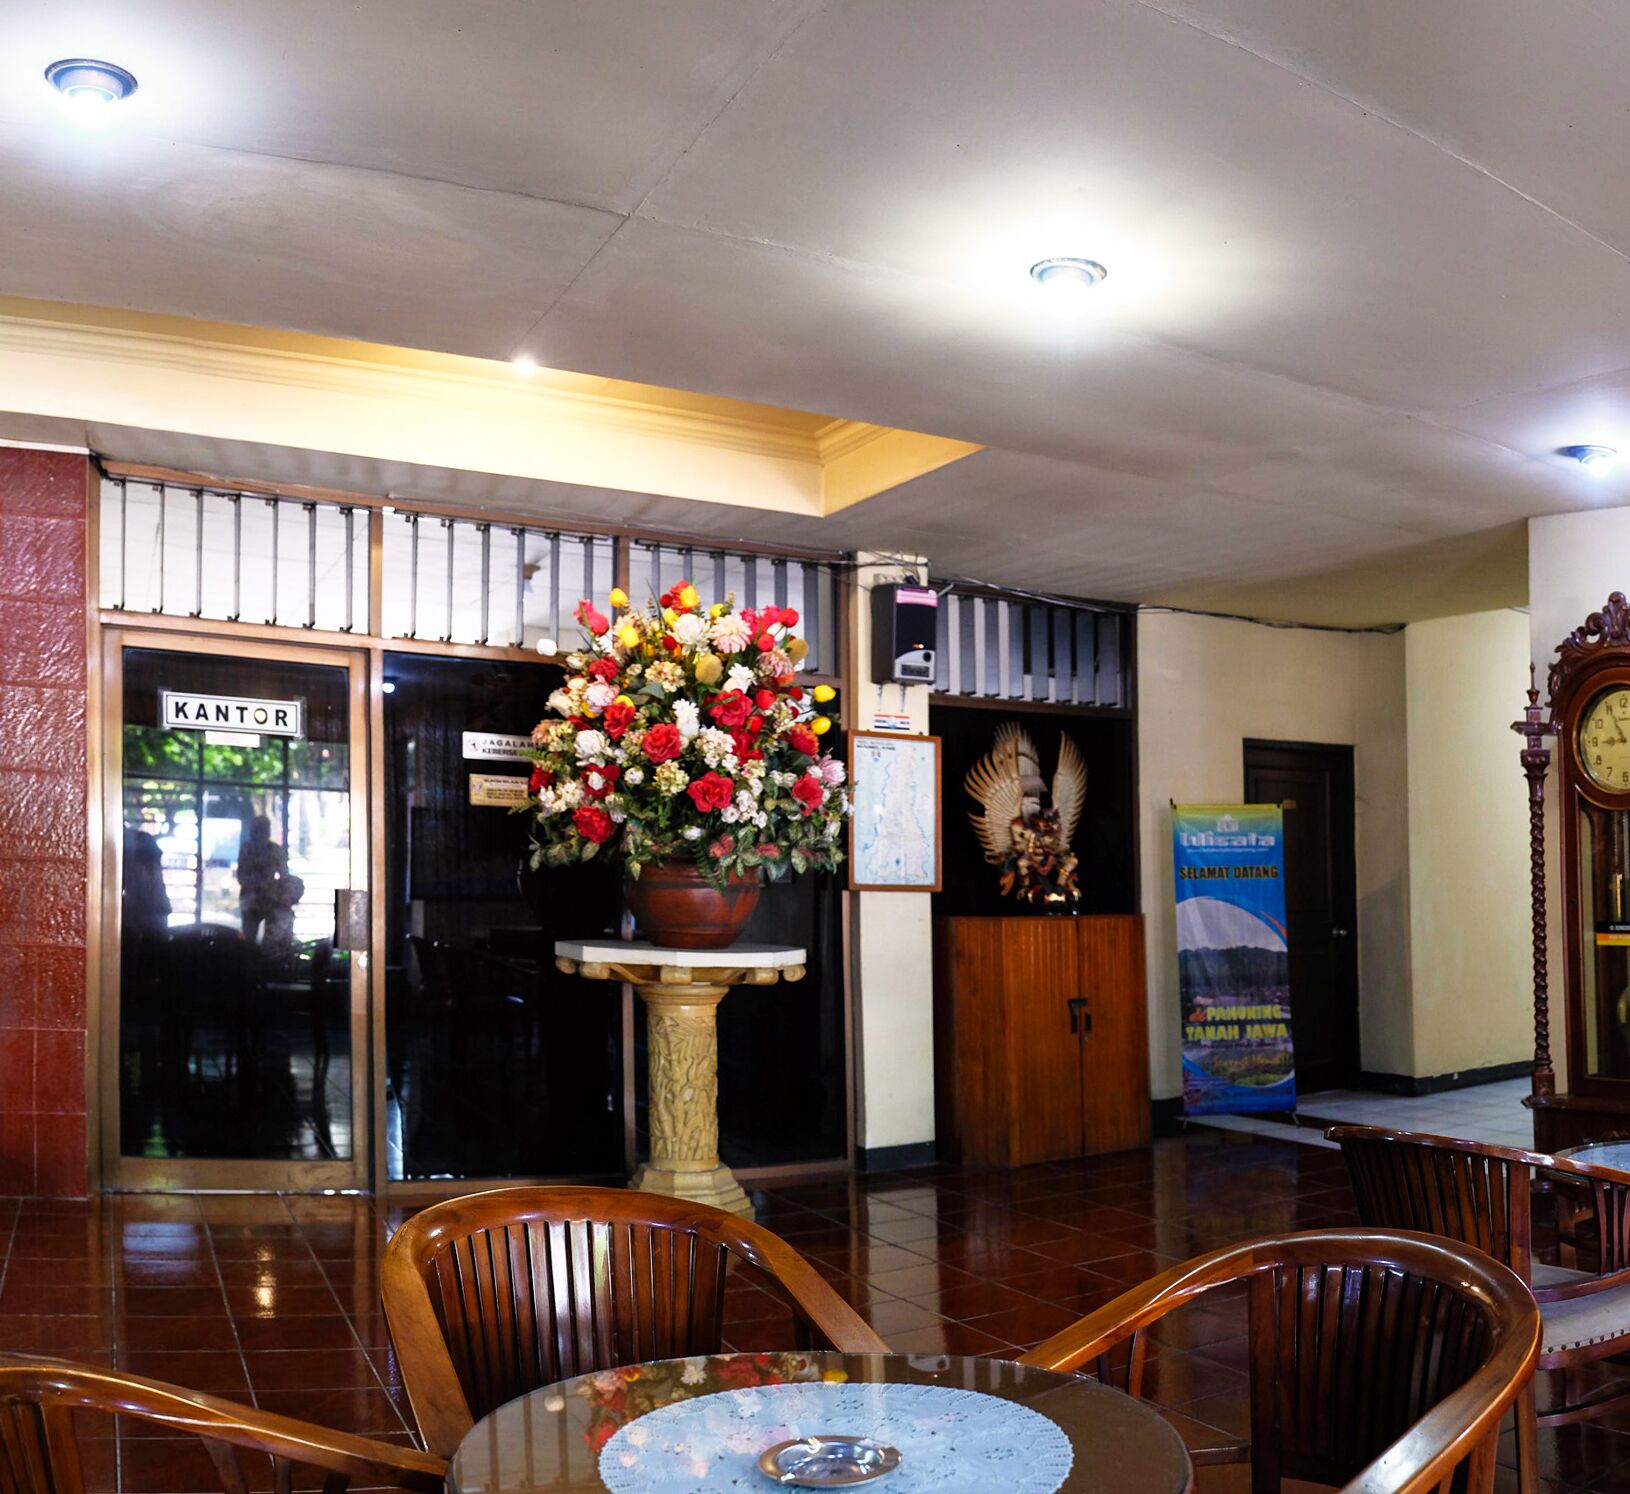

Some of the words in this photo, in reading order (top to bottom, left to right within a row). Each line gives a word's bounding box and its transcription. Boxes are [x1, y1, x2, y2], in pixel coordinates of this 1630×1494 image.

[1619, 697, 1628, 708] 12
[174, 701, 288, 727] KANTOR
[1594, 718, 1603, 729] 10
[1592, 736, 1598, 747] 9
[1595, 755, 1602, 765] 8
[1606, 766, 1613, 780] 7
[1622, 771, 1629, 782] 6
[1180, 831, 1276, 846] Wisata
[1179, 866, 1230, 880] SELAMAT
[1233, 865, 1279, 879] DATANG
[1185, 1025, 1240, 1041] TANAH
[1246, 1023, 1288, 1039] JAWA
